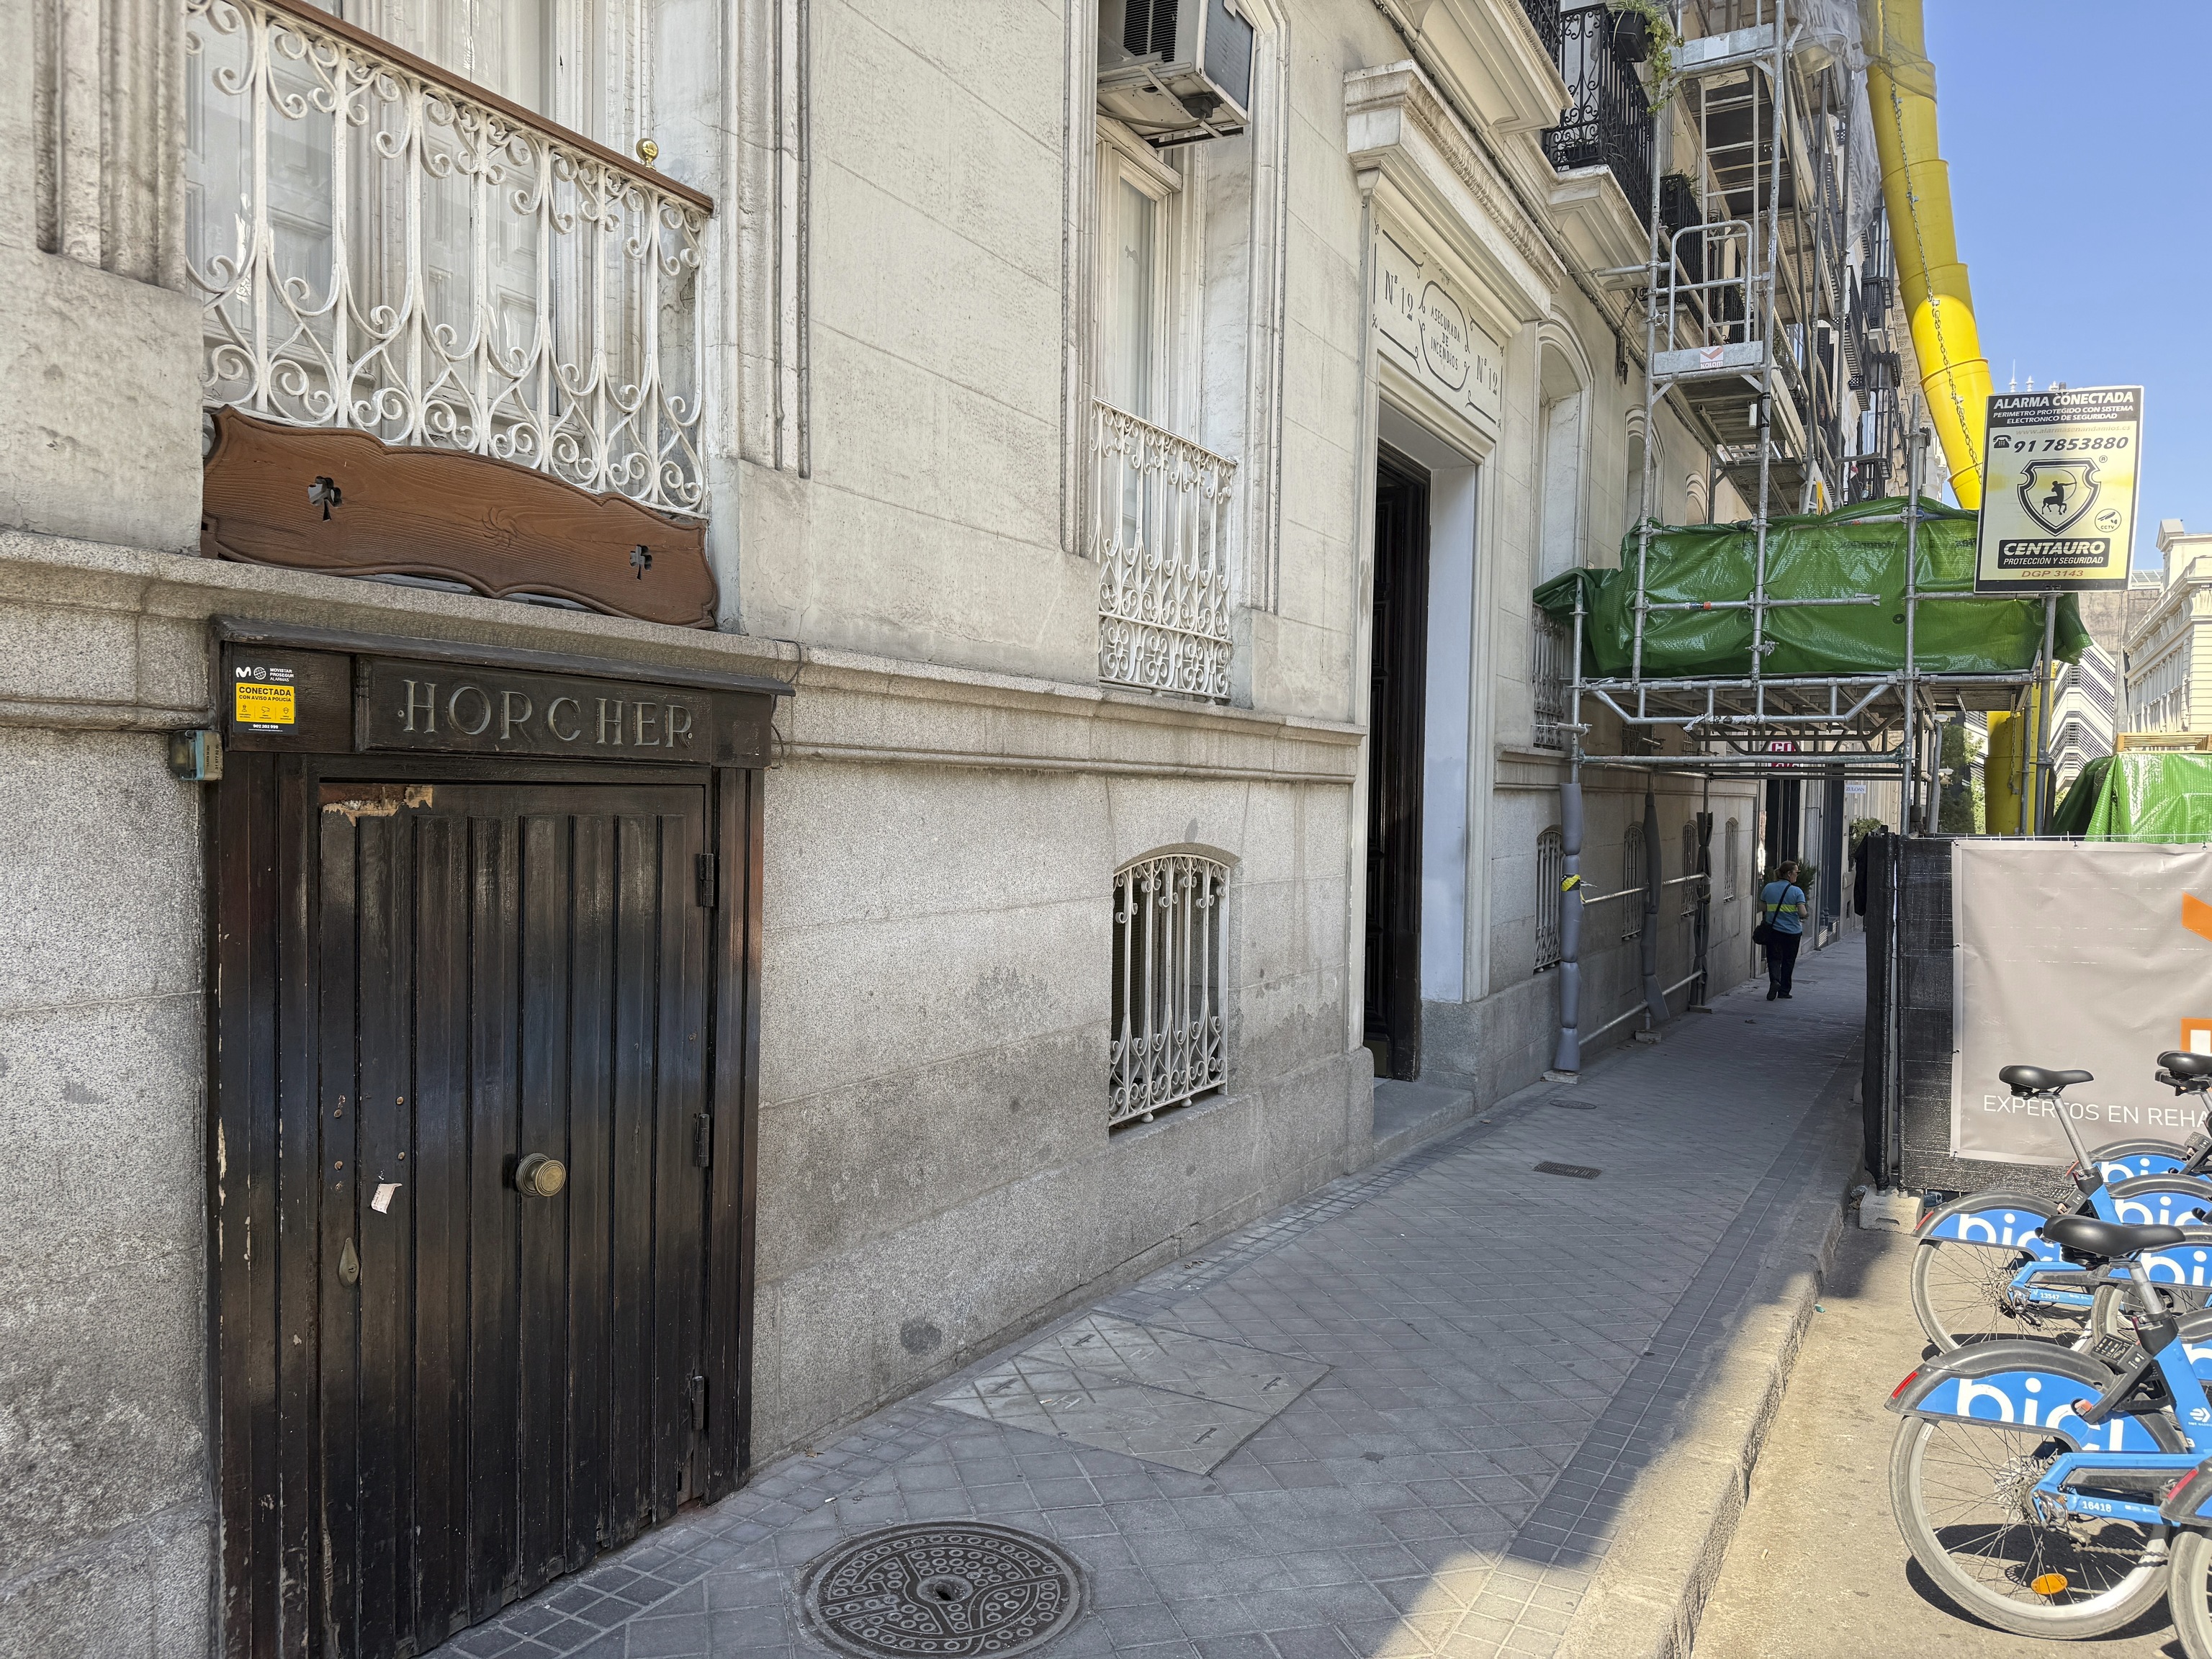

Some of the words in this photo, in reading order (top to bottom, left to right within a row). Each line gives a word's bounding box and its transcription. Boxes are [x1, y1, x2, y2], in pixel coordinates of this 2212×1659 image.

[1401, 287, 1413, 322] 12
[1442, 332, 1449, 347] DE
[1431, 336, 1458, 370] INCENDIOS
[1488, 368, 1498, 396] 12
[1993, 396, 2050, 410] ALARMA
[2052, 392, 2134, 406] CONECTADA
[1993, 410, 2036, 418] PERIMETRO
[2036, 408, 2082, 416] PROTEGIDO
[2006, 415, 2060, 424] ELECTRONICO
[2014, 440, 2036, 453] 91
[2042, 436, 2128, 451] 7853880
[2003, 541, 2105, 556] CENTAURO
[2003, 556, 2051, 565] PROTECCIÓN
[2059, 556, 2104, 565] SEGURIDAD
[239, 686, 292, 696] CONECTADA
[403, 679, 693, 750] HORCHER
[1984, 1094, 2100, 1121] EXPEROS
[2108, 1105, 2139, 1125] EN
[2082, 1501, 2112, 1513] 16418
